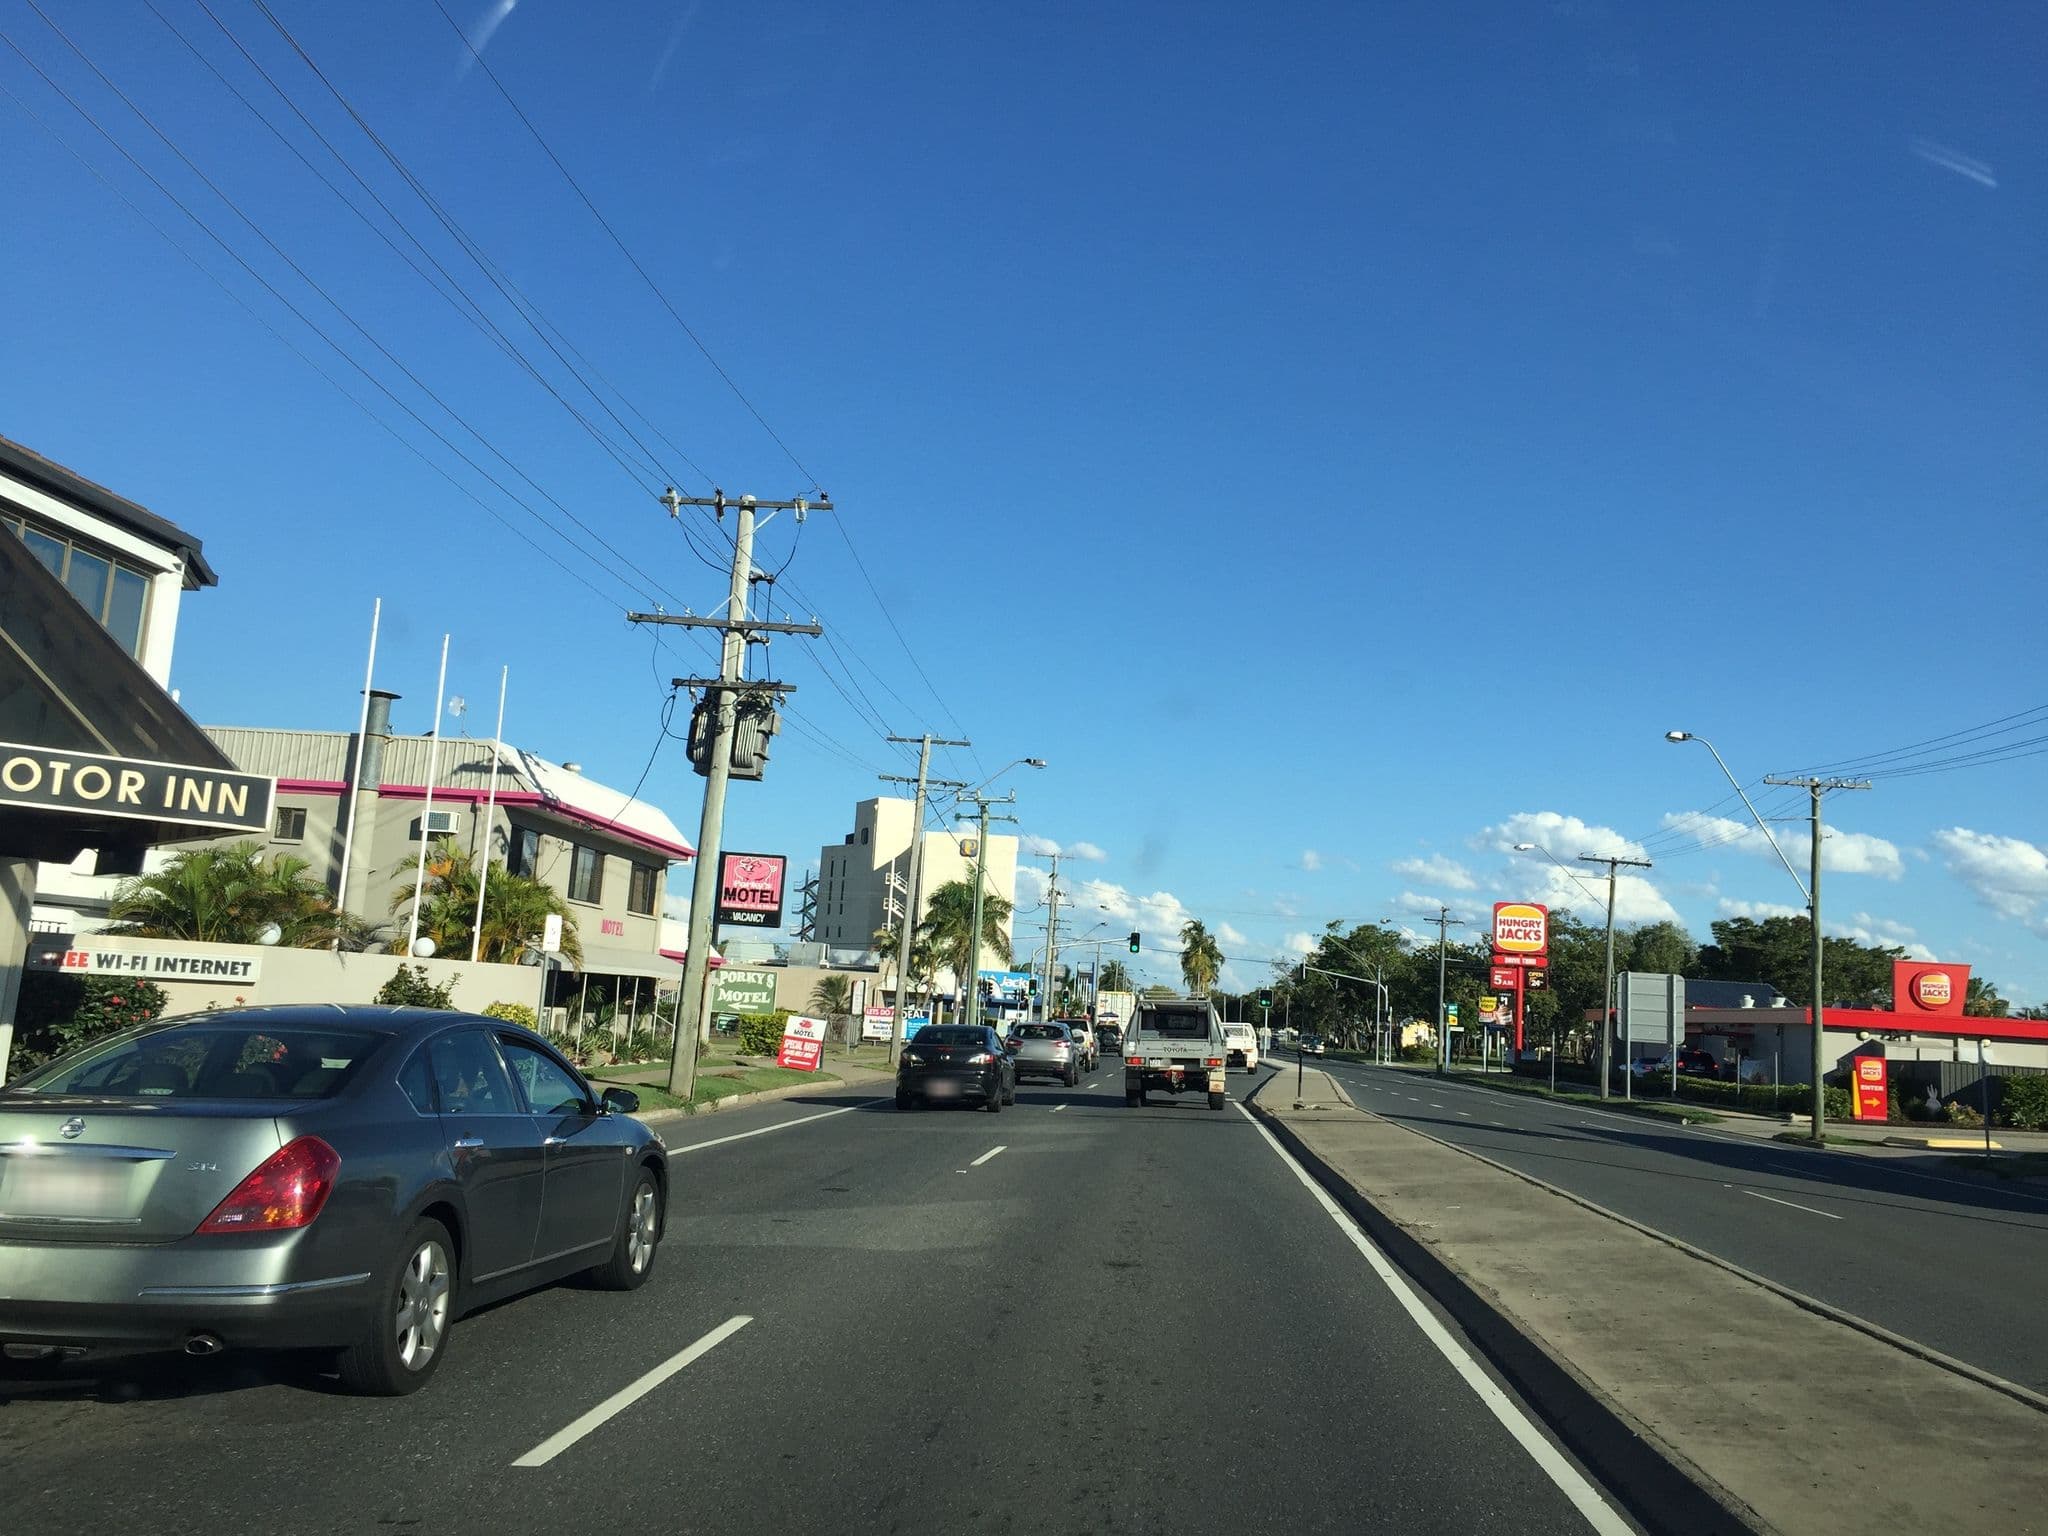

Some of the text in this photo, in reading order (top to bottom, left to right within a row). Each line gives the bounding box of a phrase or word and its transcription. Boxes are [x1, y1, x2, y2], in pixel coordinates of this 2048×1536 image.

[2, 756, 249, 817] OTOR INN
[723, 887, 779, 904] MOTEL
[732, 912, 766, 923] VACANCY
[1499, 918, 1542, 929] HUNGRY
[600, 919, 624, 937] MOTEL
[96, 952, 148, 972] WI-FI
[154, 956, 252, 977] INTERNET
[1493, 975, 1502, 985] 5
[717, 988, 770, 1003] MOTEL
[794, 1029, 815, 1038] MOTEL
